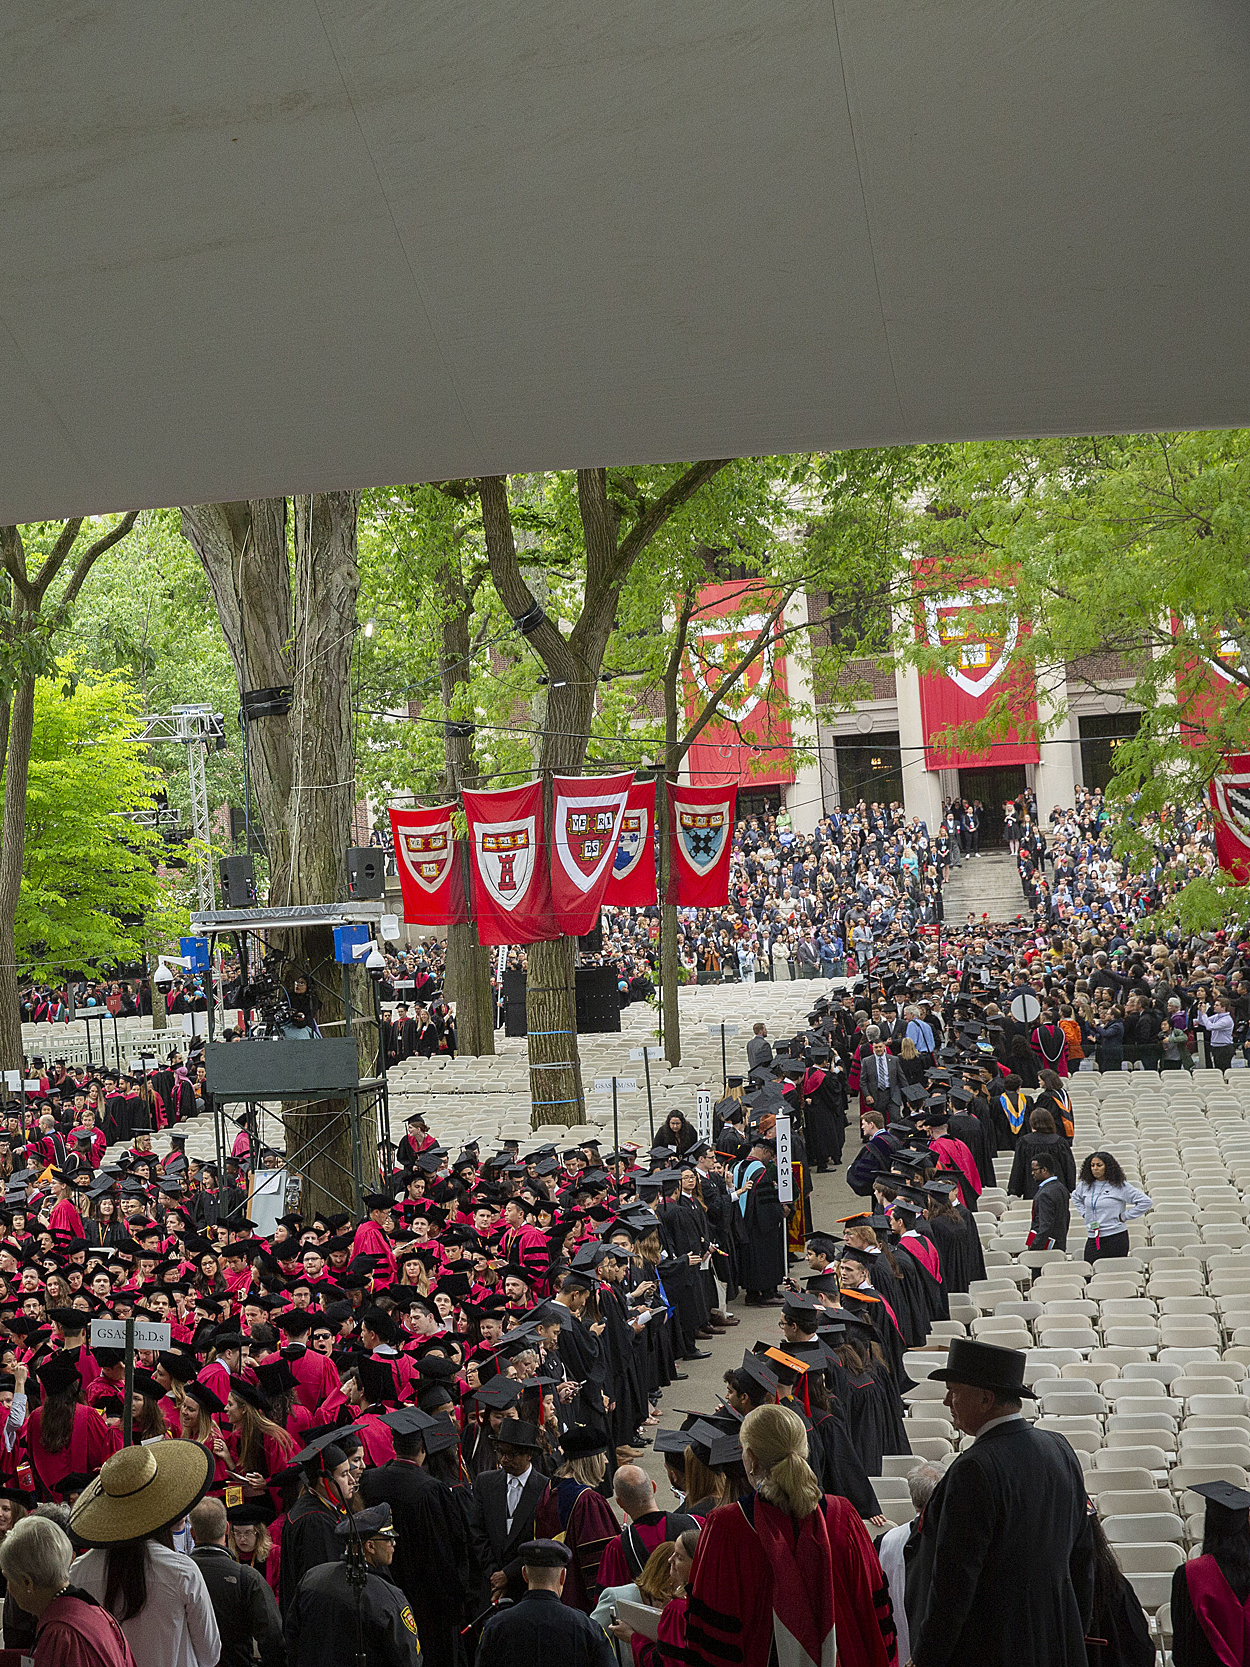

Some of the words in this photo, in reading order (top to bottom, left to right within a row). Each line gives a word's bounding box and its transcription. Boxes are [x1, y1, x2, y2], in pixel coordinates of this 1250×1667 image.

[572, 818, 586, 827] VE
[598, 816, 612, 826] RI
[585, 844, 599, 853] TAS
[424, 865, 436, 873] TAS
[780, 1133, 790, 1188] ADAMS
[97, 1328, 128, 1340] GSAS
